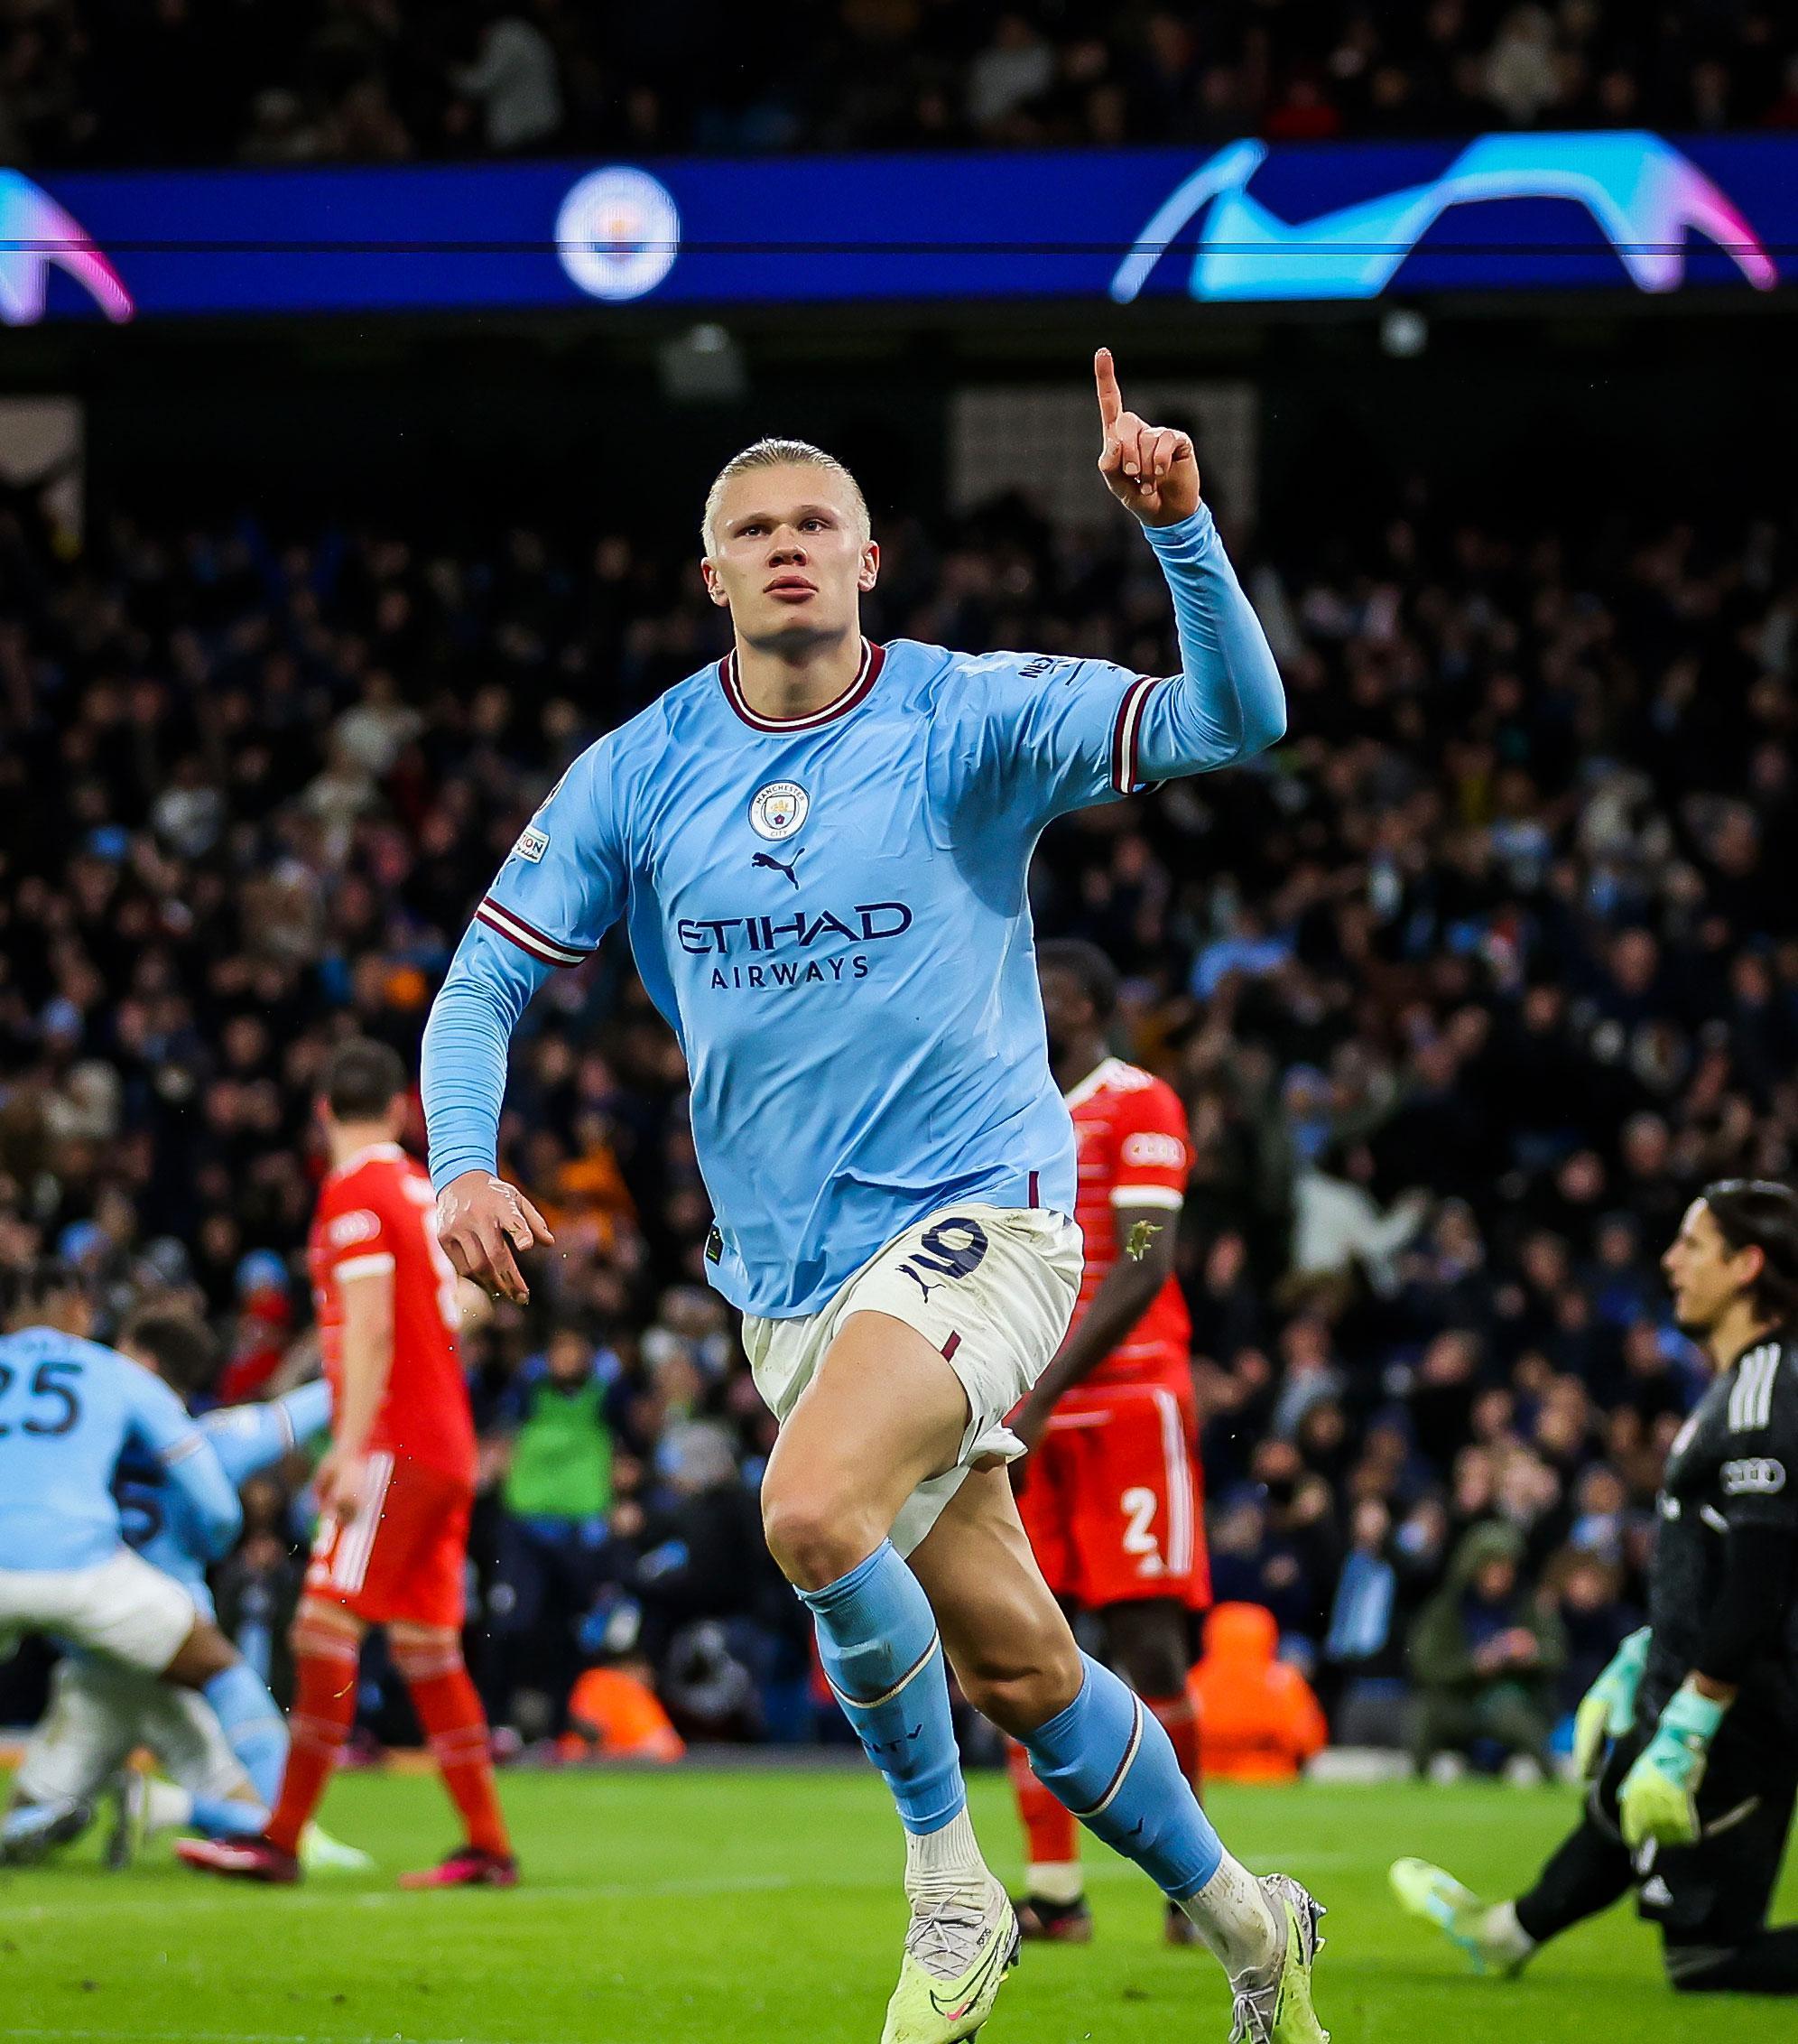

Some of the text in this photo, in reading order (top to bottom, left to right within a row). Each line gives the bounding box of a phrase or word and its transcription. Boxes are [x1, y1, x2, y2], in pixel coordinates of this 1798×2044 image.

[755, 785, 805, 804] MANCHESTER
[677, 902, 913, 954] ETIHAD
[710, 954, 869, 989] AIRWAYS
[0, 1361, 84, 1436] 5
[1120, 1487, 1159, 1554] 2
